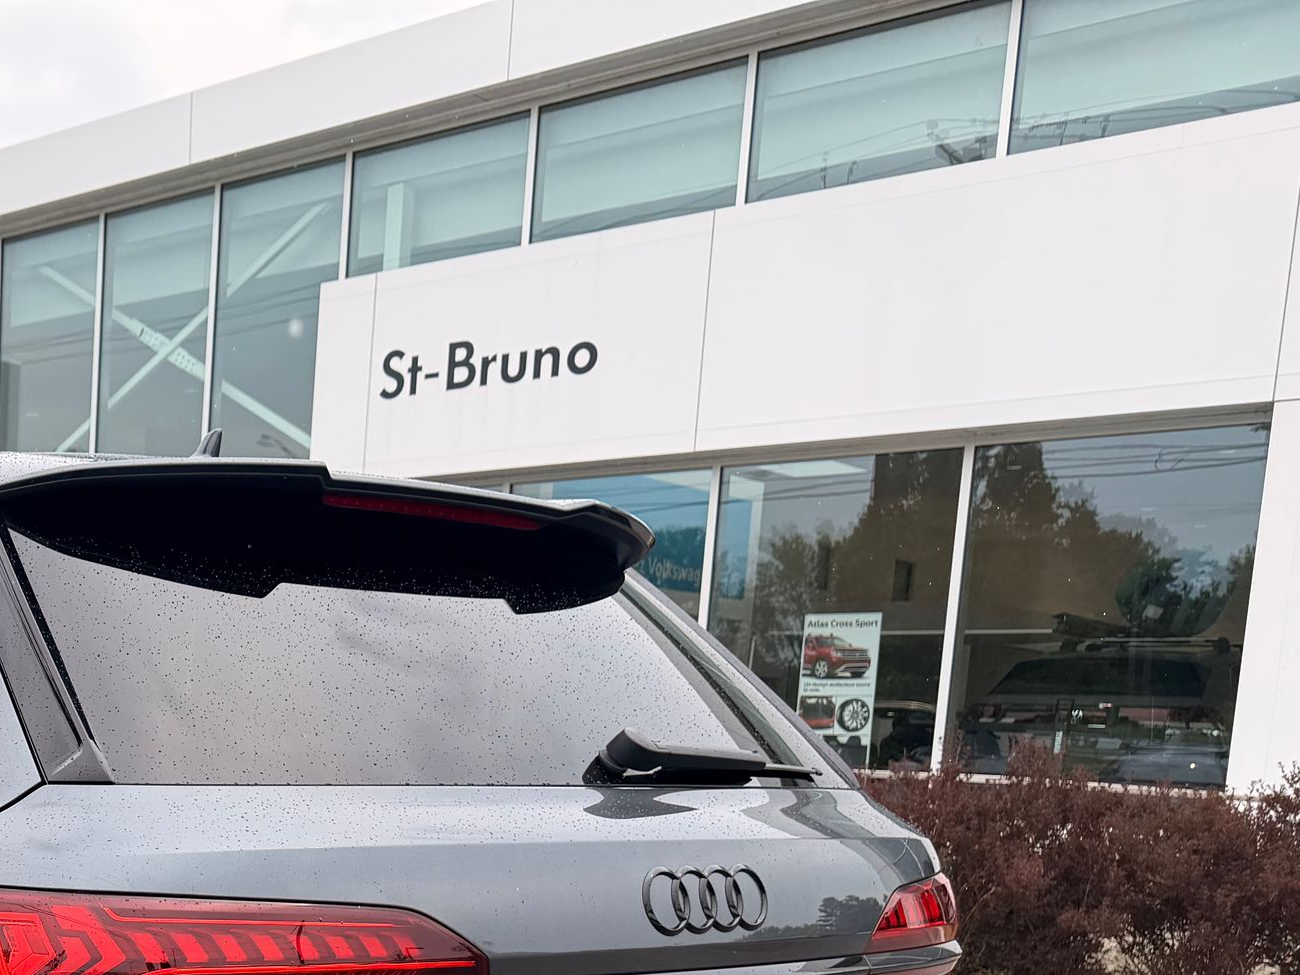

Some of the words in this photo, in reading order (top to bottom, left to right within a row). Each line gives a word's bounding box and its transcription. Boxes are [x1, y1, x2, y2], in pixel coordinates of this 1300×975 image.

[379, 340, 599, 400] St-Bruno
[807, 620, 829, 629] Atlas
[830, 619, 853, 628] Cross
[855, 617, 878, 629] Sport
